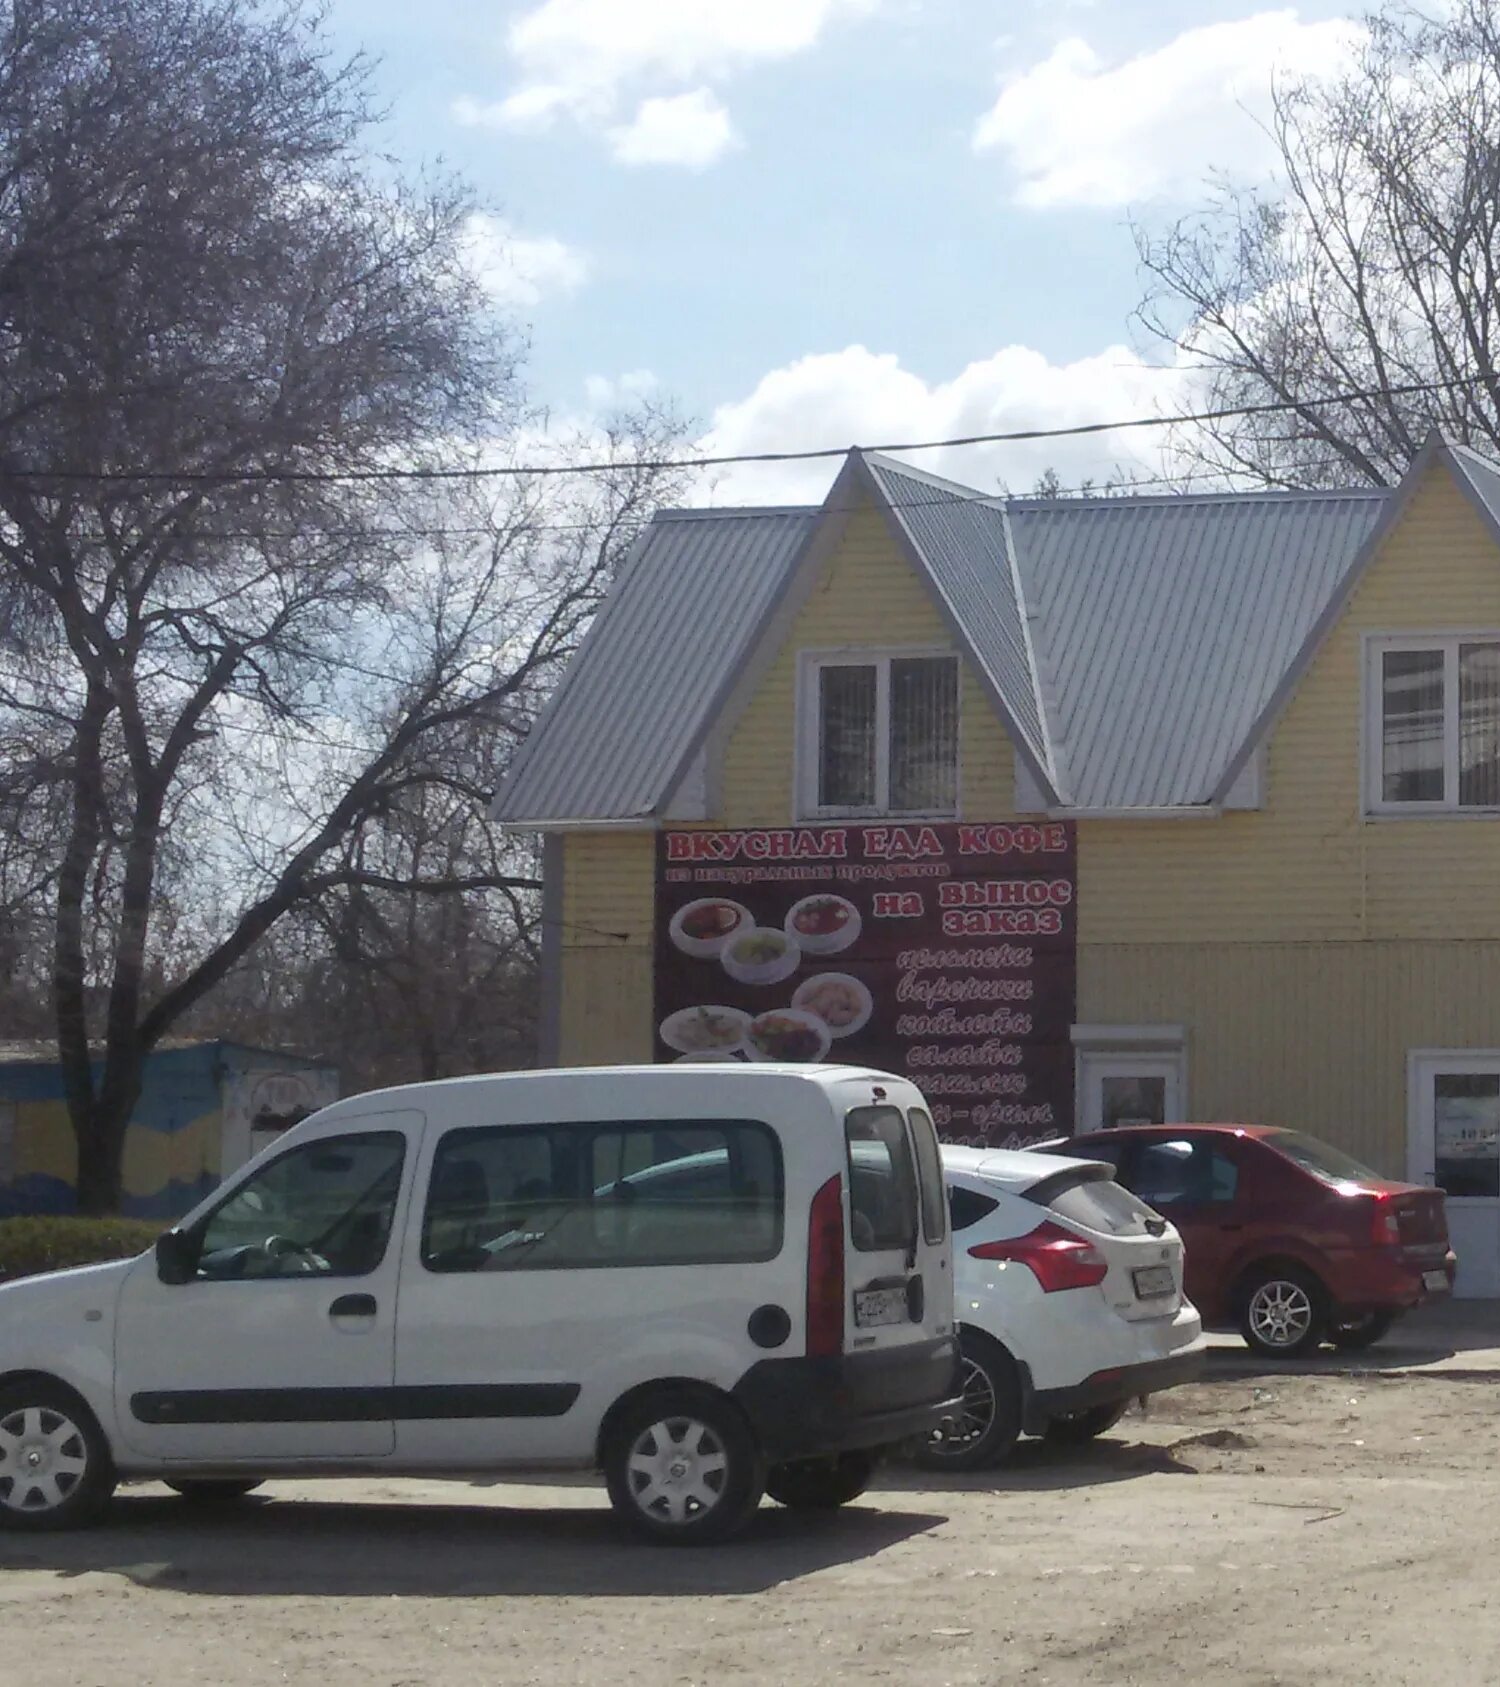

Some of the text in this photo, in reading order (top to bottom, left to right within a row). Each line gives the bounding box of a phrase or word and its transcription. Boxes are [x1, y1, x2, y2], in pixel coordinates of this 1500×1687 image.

[667, 824, 1067, 861] ВКУСНАЯ ЕДА КОФЕ
[694, 865, 833, 884] натуральных
[836, 862, 950, 881] продуктов
